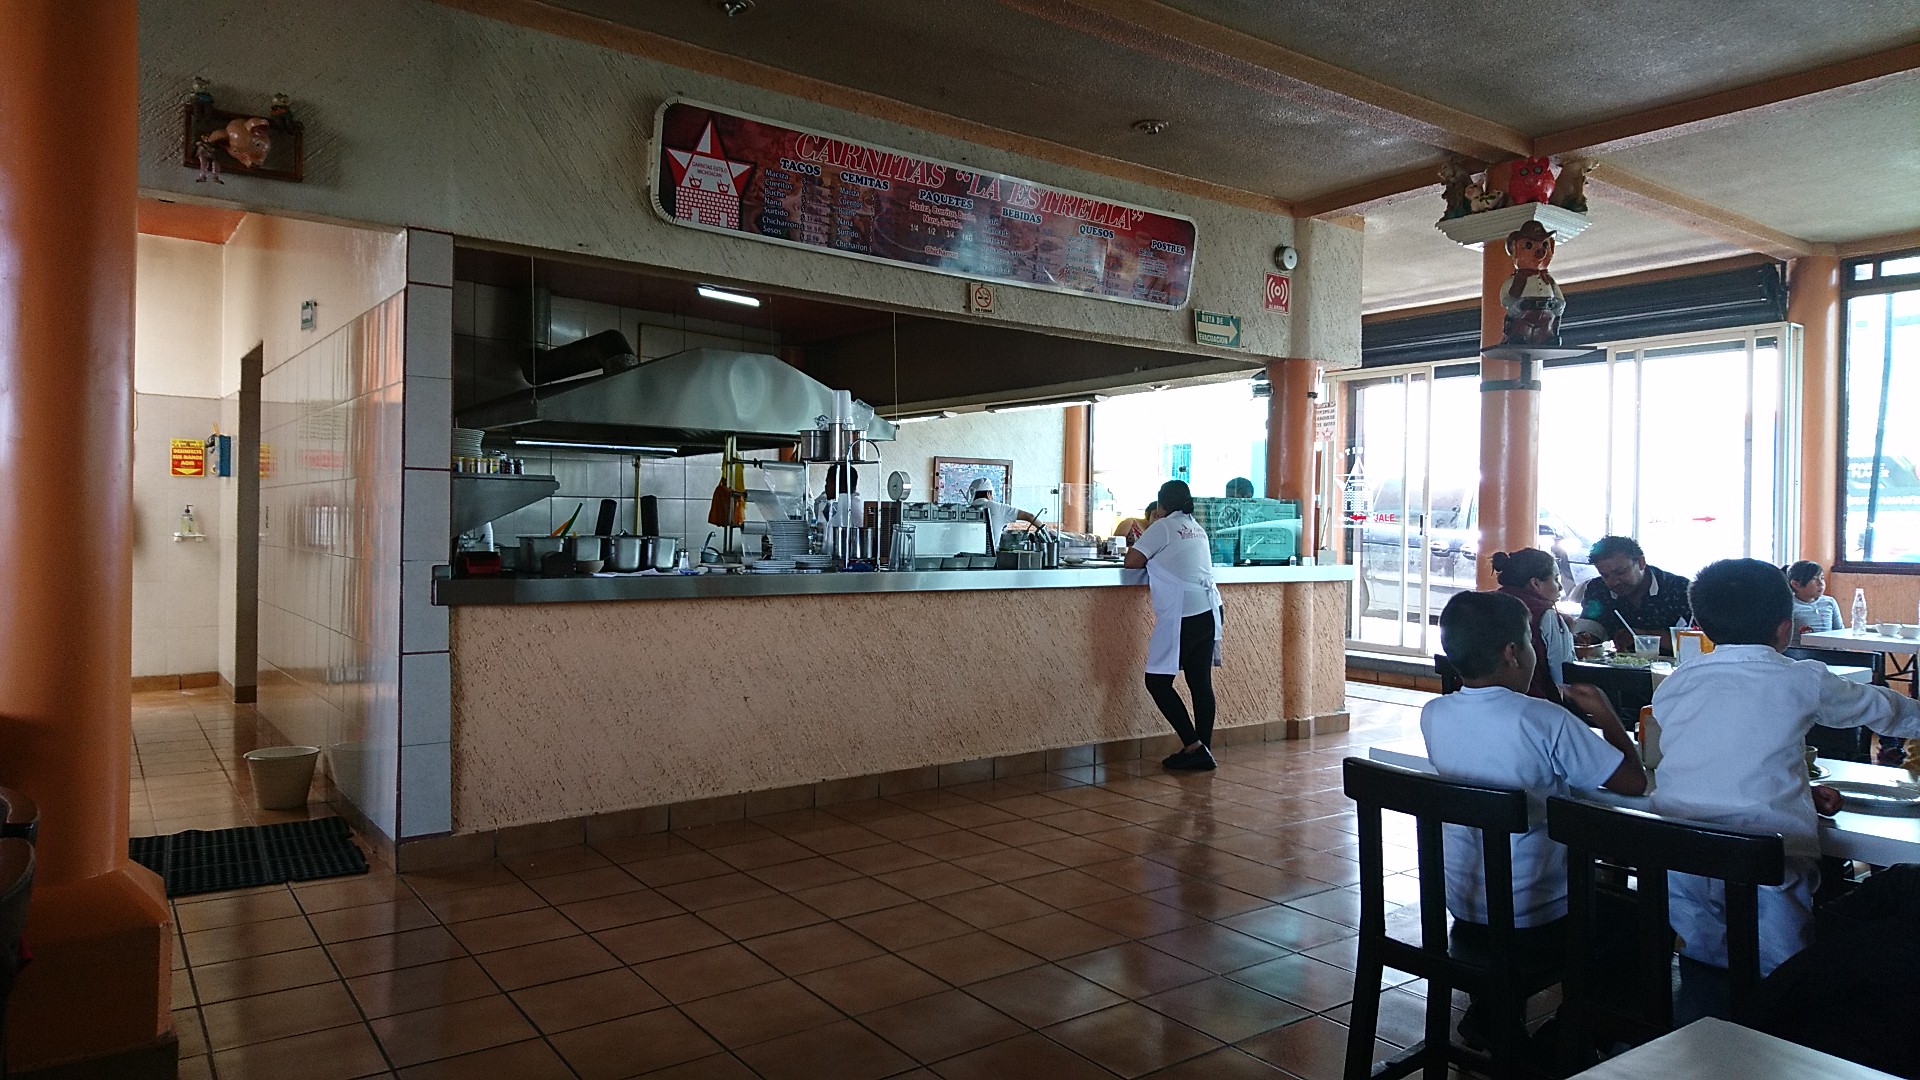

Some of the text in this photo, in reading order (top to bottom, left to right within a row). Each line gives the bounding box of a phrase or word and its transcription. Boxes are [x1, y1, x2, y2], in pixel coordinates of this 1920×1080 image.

[780, 158, 821, 176] TACOS
[796, 133, 947, 189] CARNITAS
[765, 168, 789, 180] Maciza
[765, 178, 793, 190] Cueritos
[840, 171, 889, 191] CEMITAS
[764, 187, 786, 198] Buche
[764, 196, 782, 207] Nana
[919, 189, 973, 209] PAQUETES
[763, 206, 788, 217] Surtido
[1002, 207, 1042, 224] BEBIDAS
[763, 225, 782, 235] Sesos
[928, 227, 936, 235] 1/2
[1079, 225, 1114, 239] QUESOS
[1151, 240, 1185, 255] POSTRES
[1201, 315, 1224, 325] RUTA DE
